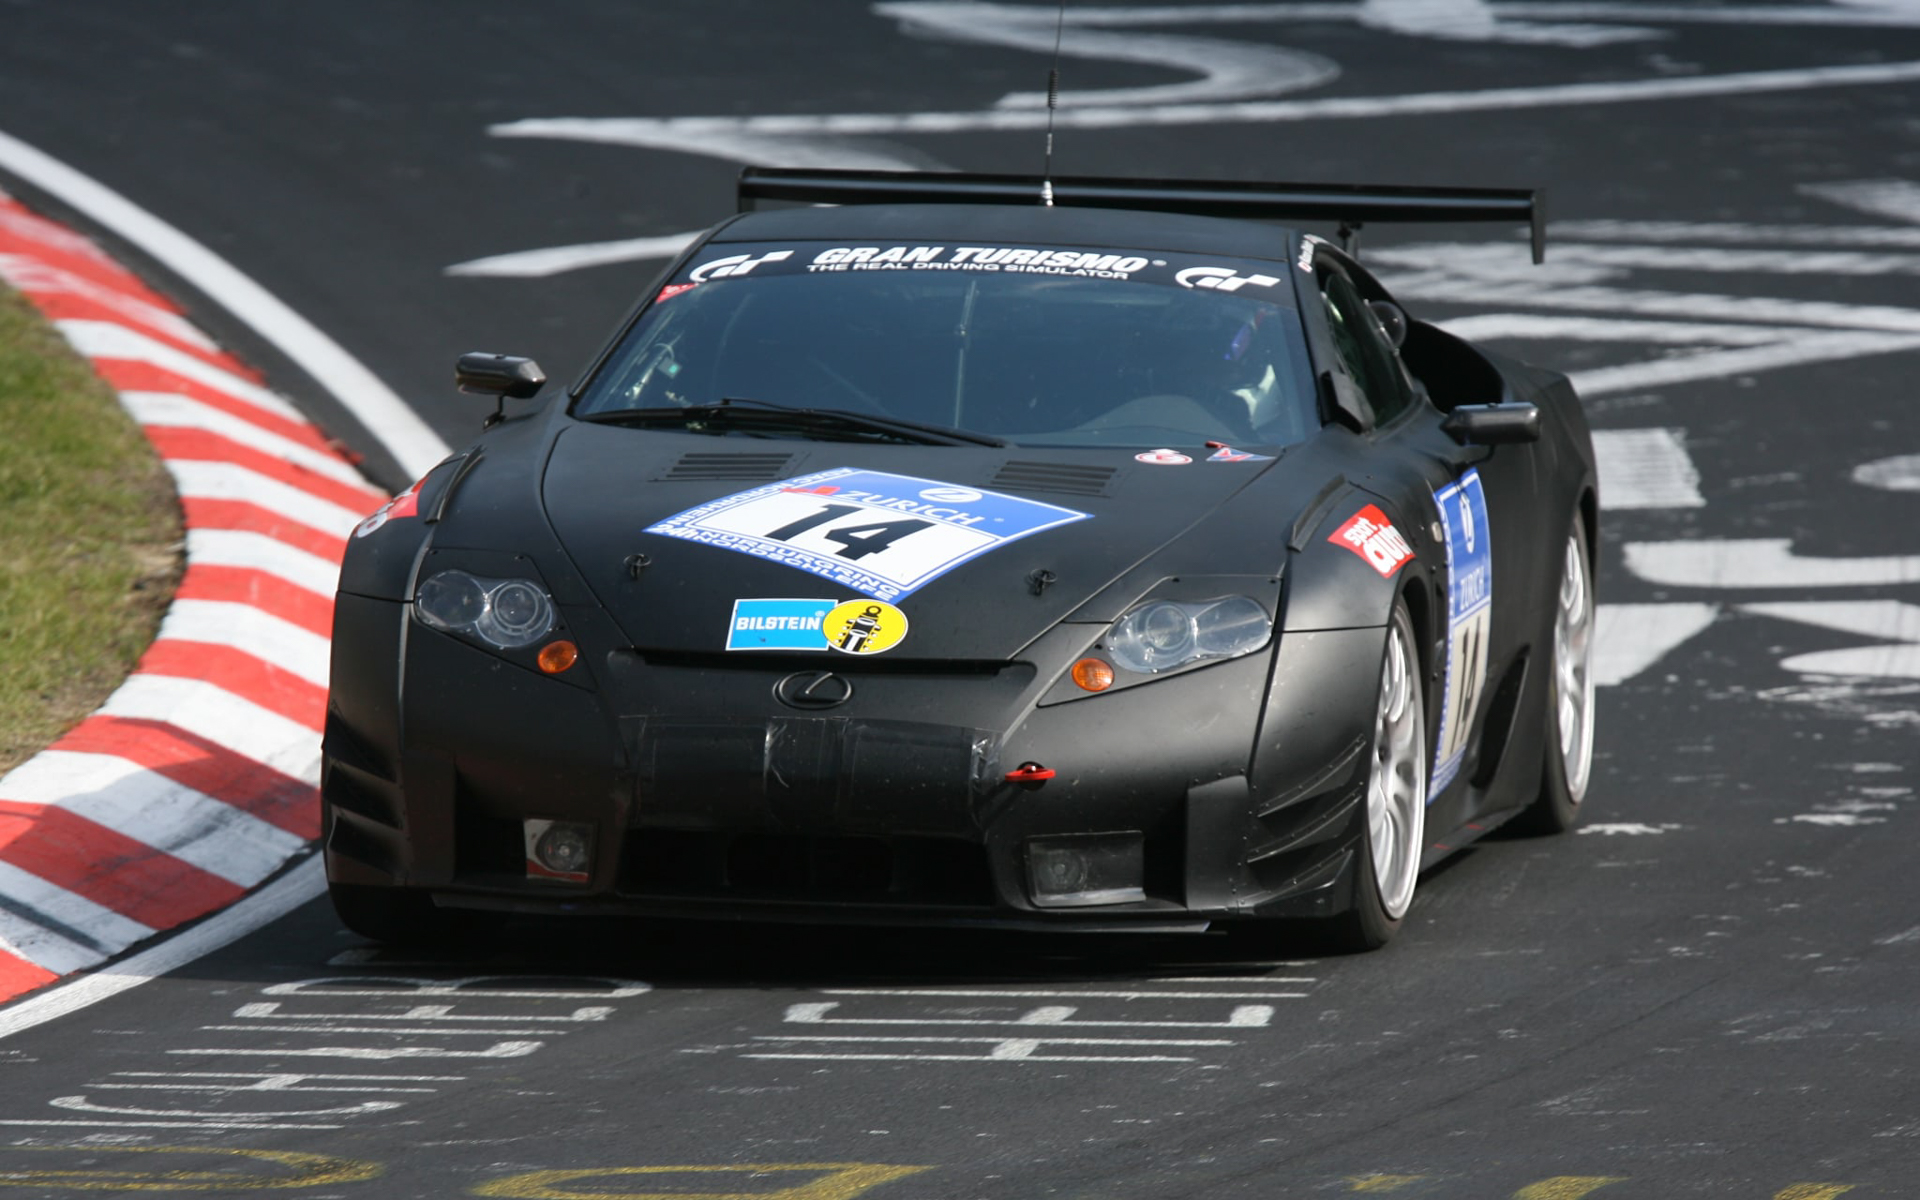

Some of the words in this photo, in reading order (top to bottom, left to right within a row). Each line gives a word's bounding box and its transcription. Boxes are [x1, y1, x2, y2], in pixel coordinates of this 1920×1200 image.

[806, 264, 849, 273] THE
[852, 262, 908, 271] REAL
[912, 262, 999, 271] DRIVING
[1004, 263, 1129, 280] SIMULATOR
[812, 246, 945, 265] GRAN
[949, 247, 1149, 273] TURISMO
[833, 490, 985, 526] ZURICH
[764, 503, 938, 562] 14
[692, 535, 894, 602] NORDSCHLEIFE
[735, 616, 821, 631] BILSTEIN
[1450, 614, 1480, 754] 14
